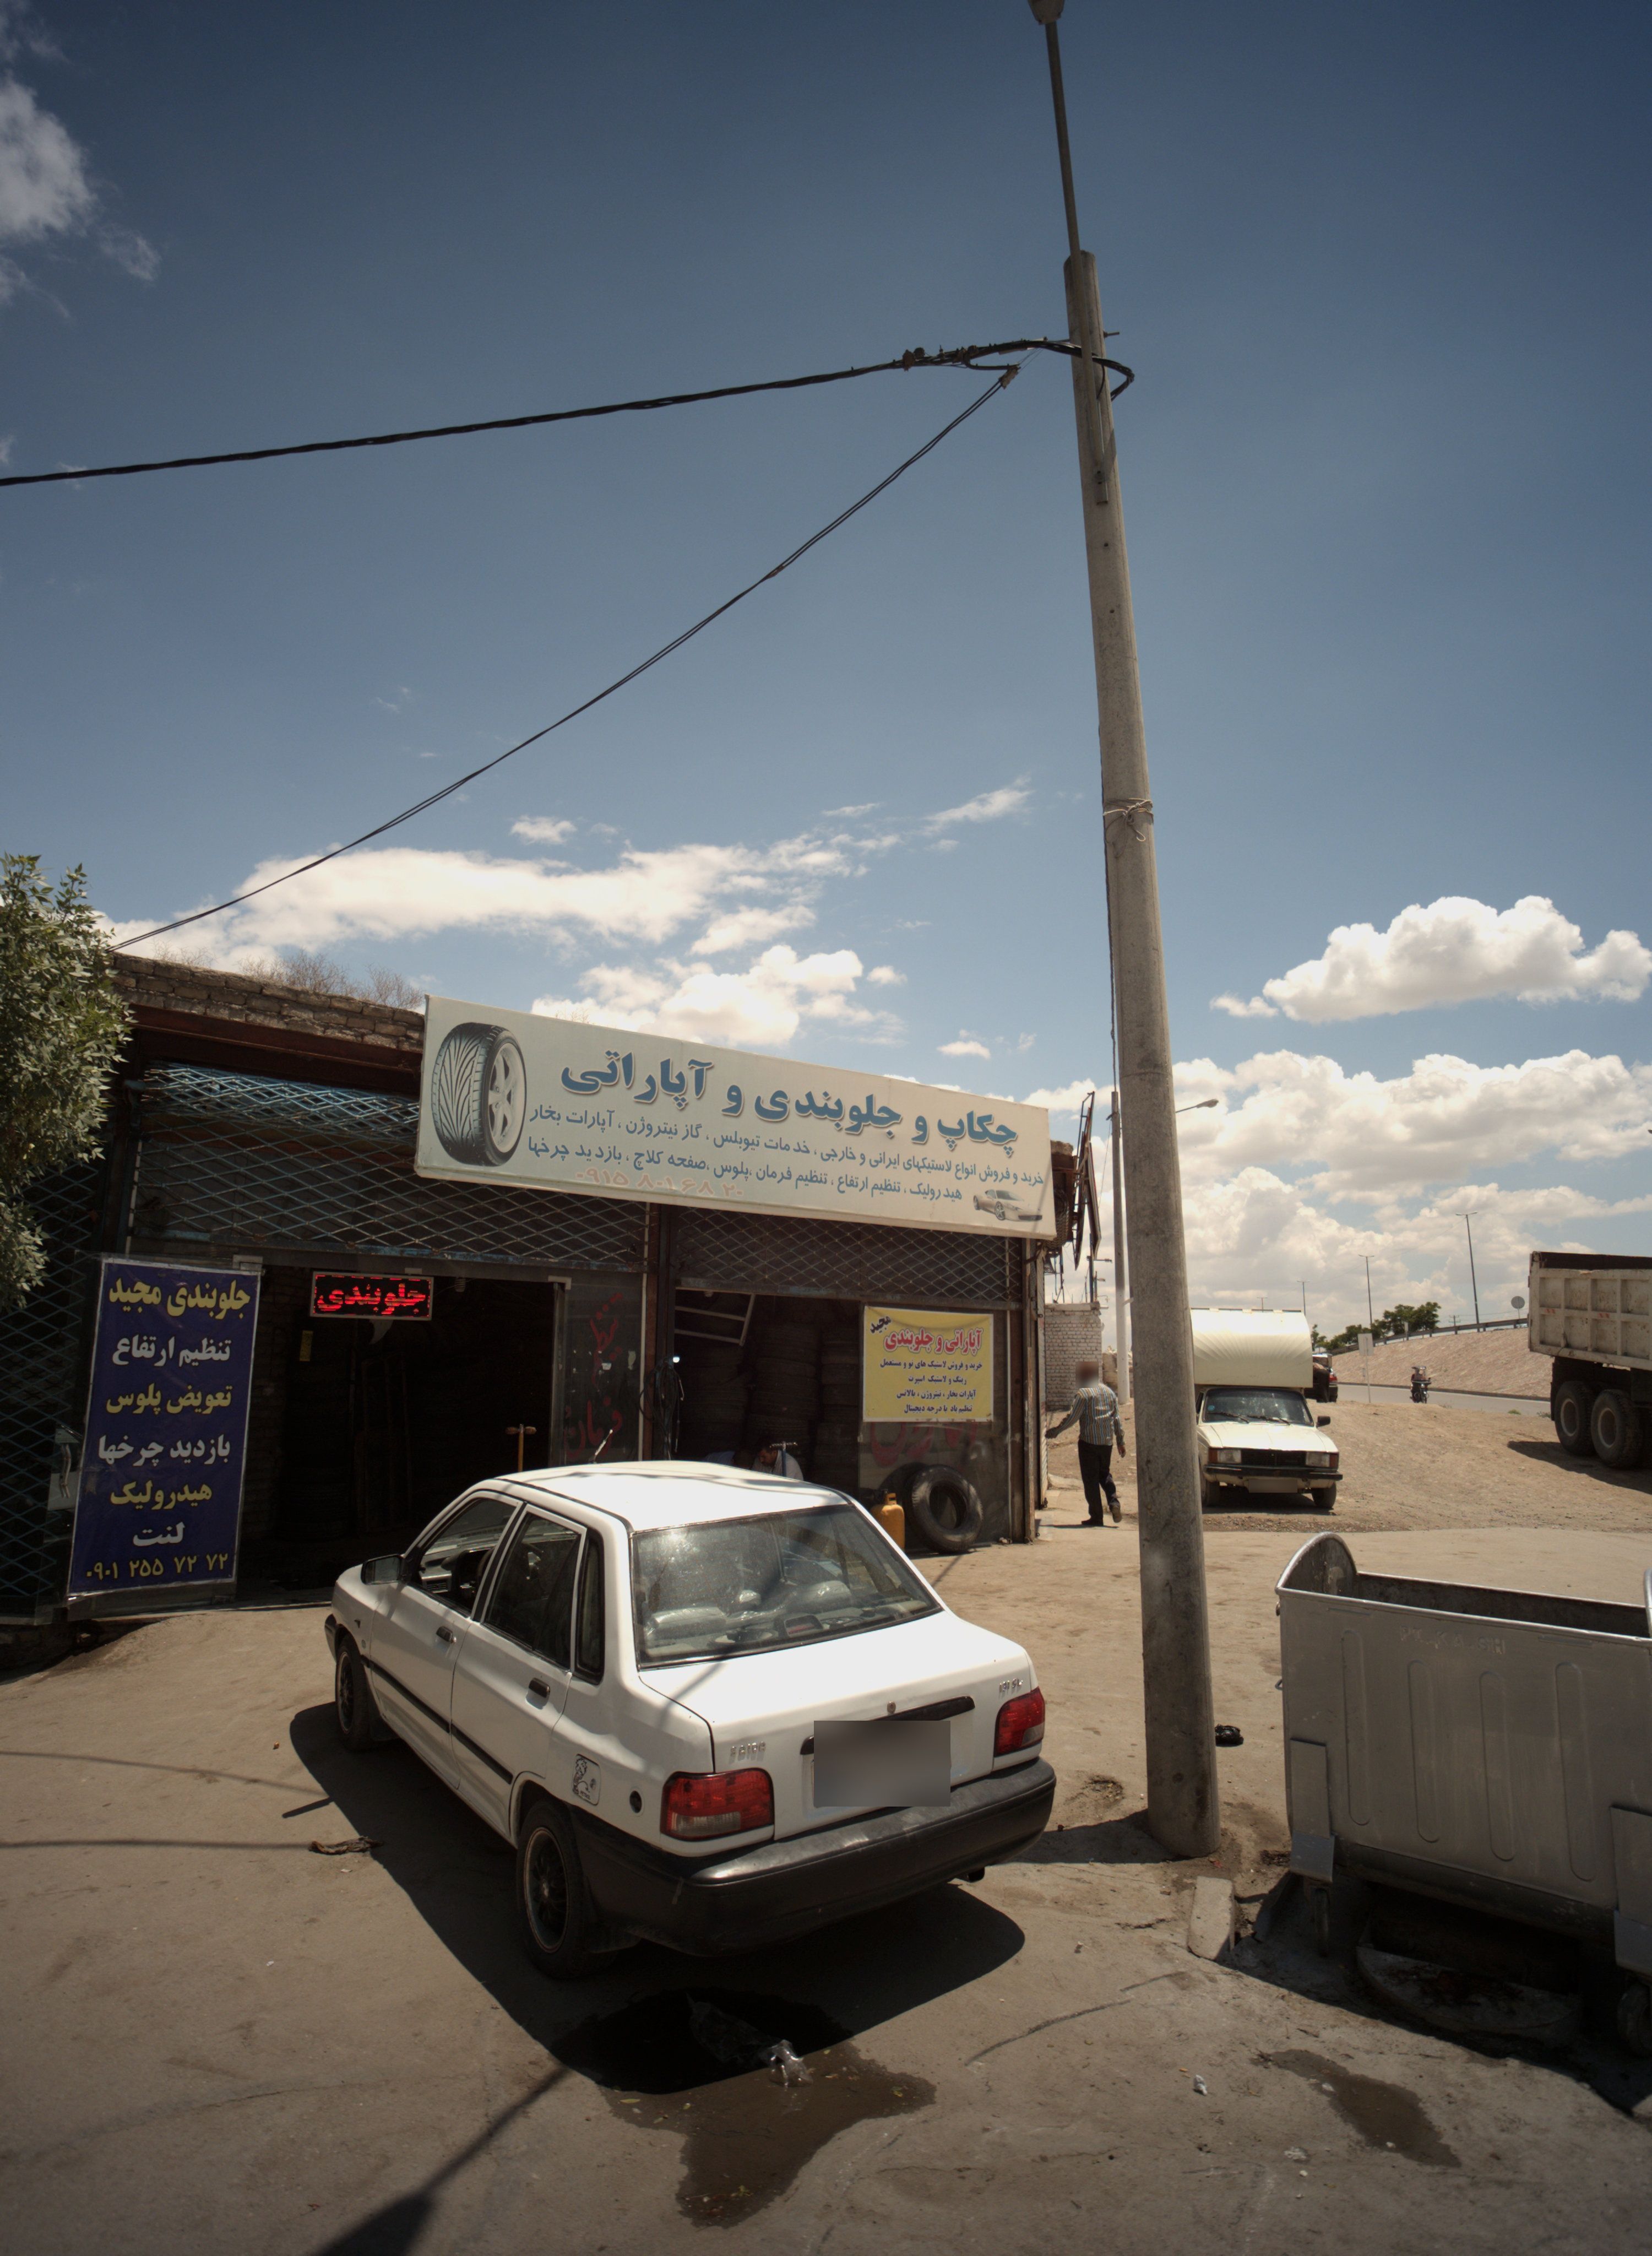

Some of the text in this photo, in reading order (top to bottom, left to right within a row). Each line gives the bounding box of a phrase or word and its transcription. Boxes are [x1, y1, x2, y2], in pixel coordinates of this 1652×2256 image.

[562, 1050, 1017, 1156] چکاپ و جلوبندی و آپاراتی
[529, 1105, 561, 1125] بخار
[566, 1110, 615, 1133] آپارات
[682, 1124, 702, 1141] گاز
[634, 1150, 663, 1170] کلاچ
[869, 1152, 899, 1169] ایرانی
[903, 1157, 951, 1173] لاستیکهای
[756, 1165, 792, 1183] فرمان
[796, 1170, 828, 1189] تنظیم
[955, 1162, 976, 1180] انواع
[979, 1165, 1009, 1181] فروش
[1021, 1172, 1043, 1185] خرید
[837, 1174, 867, 1193] ارتفاع
[871, 1179, 900, 1197] تنظیم
[109, 1278, 251, 1320] جلوبندی مجید
[870, 1316, 891, 1333] مجید
[884, 1328, 982, 1354] آپاراتی و جلوبندی
[112, 1335, 232, 1367] تنظیم ارتفاع
[969, 1361, 982, 1370] خرید
[106, 1383, 233, 1414] تعویض پلوس
[98, 1434, 230, 1467] بازدید چرخها
[111, 1480, 212, 1510] هیدرولیک
[133, 1521, 186, 1547] لنت
[129, 1558, 164, 1577] ۲۵۵
[174, 1555, 197, 1574] ۷۲
[206, 1553, 228, 1571] ۷۲
